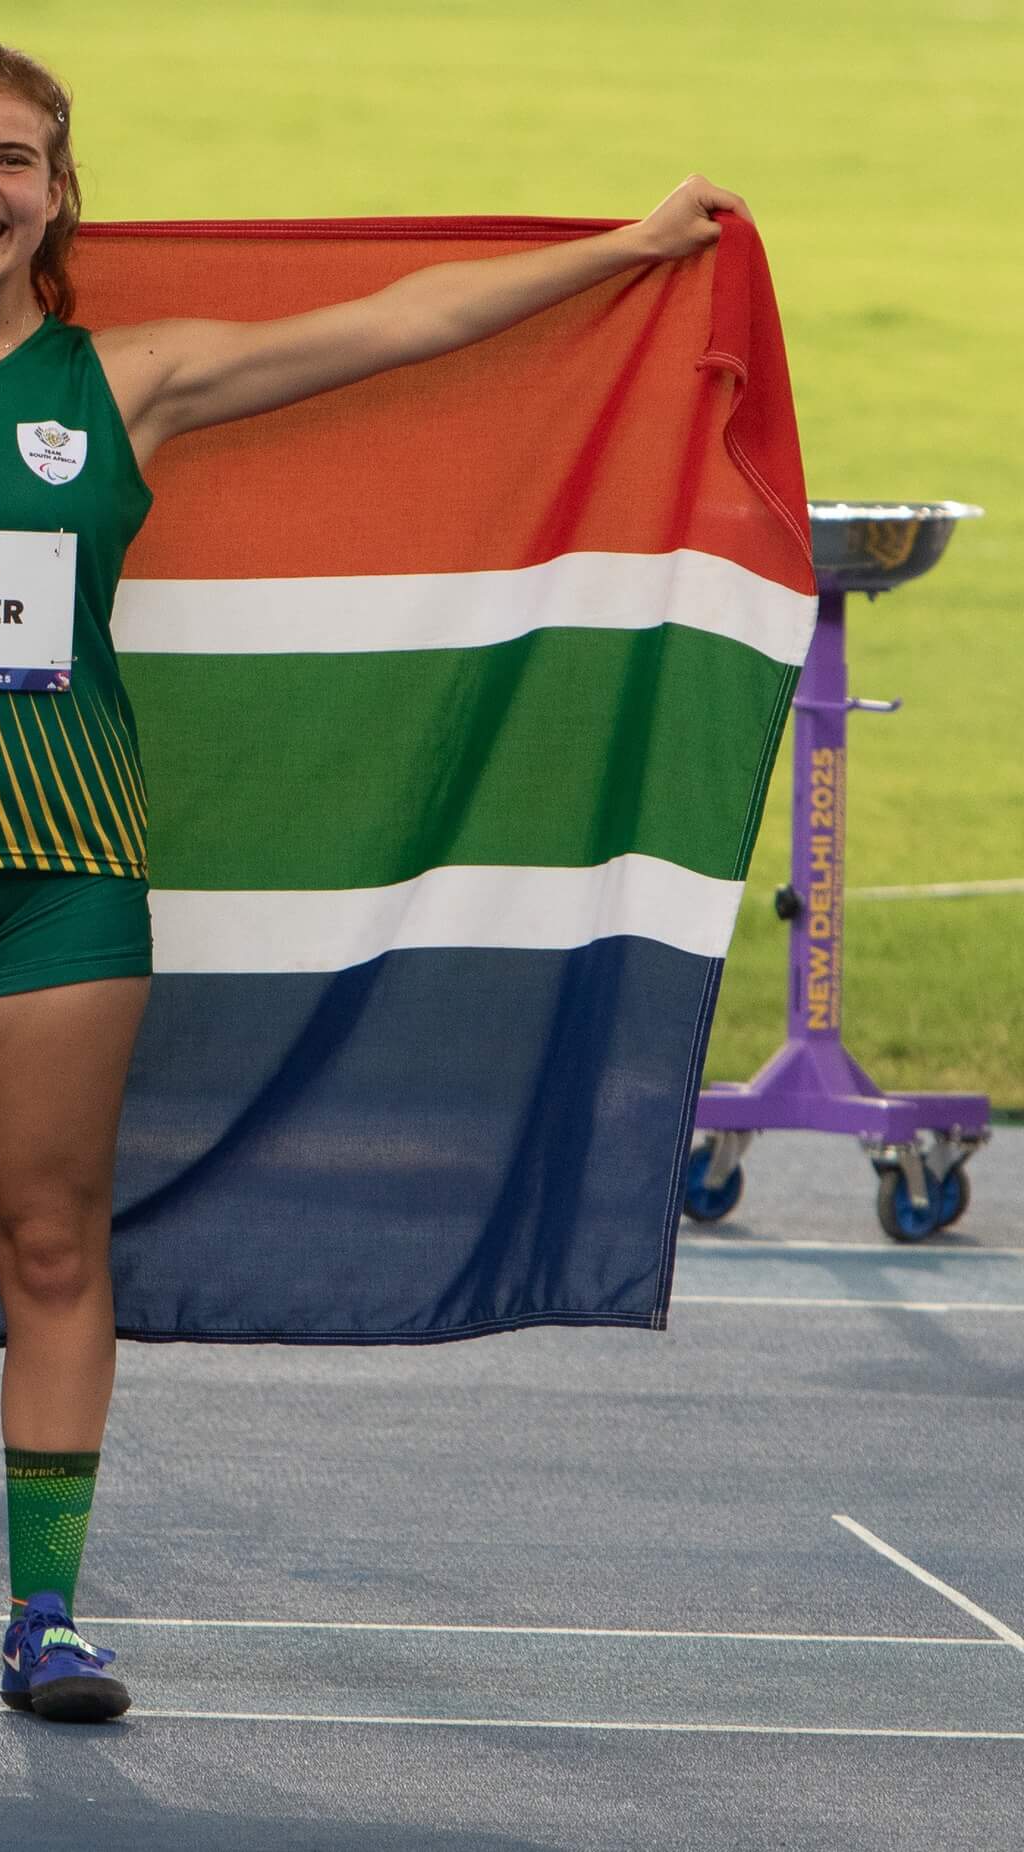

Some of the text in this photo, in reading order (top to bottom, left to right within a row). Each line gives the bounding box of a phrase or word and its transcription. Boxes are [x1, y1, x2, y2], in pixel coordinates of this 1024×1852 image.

[53, 456, 77, 464] AFRICA
[808, 748, 834, 1030] NEW DELHI 2025
[24, 1467, 65, 1477] AFRICA
